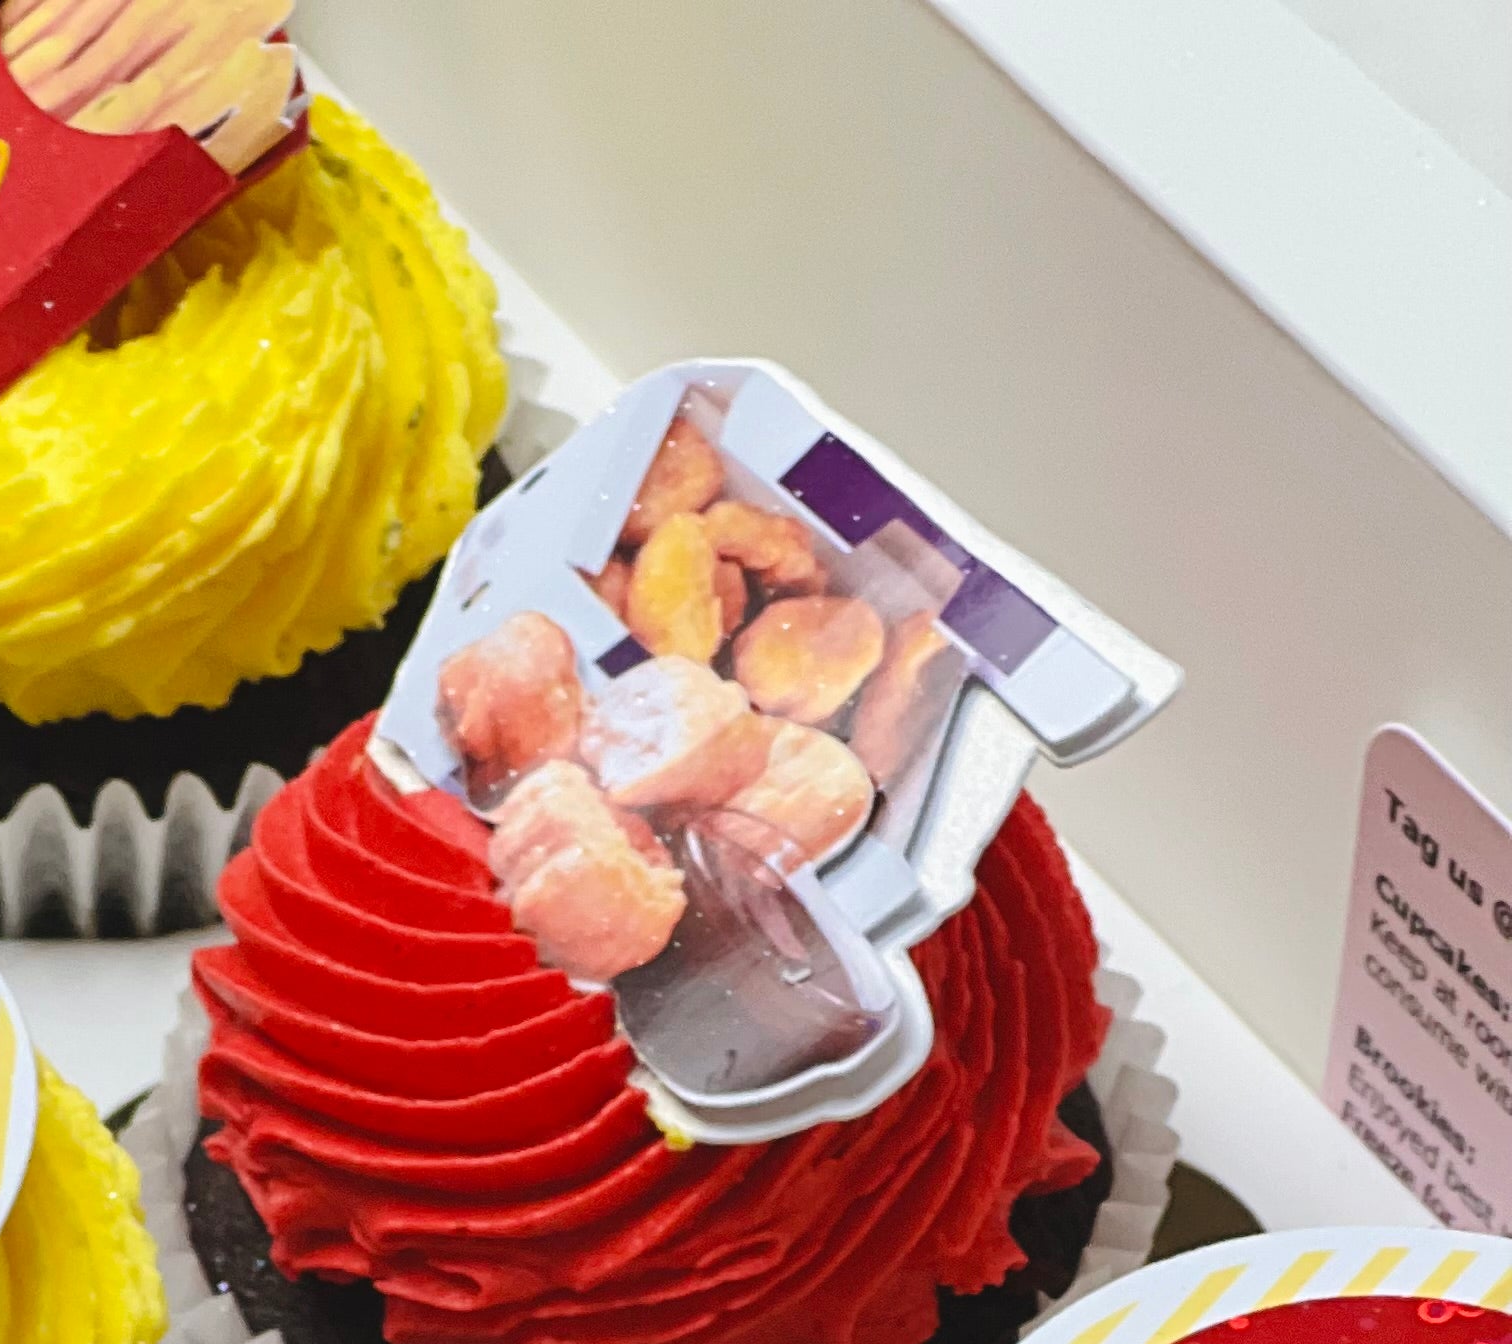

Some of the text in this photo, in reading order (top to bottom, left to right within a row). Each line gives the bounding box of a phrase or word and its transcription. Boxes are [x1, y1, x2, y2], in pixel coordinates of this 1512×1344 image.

[1385, 787, 1438, 869] Tag
[1448, 858, 1483, 907] us
[1375, 873, 1510, 1021] Cupcakes:
